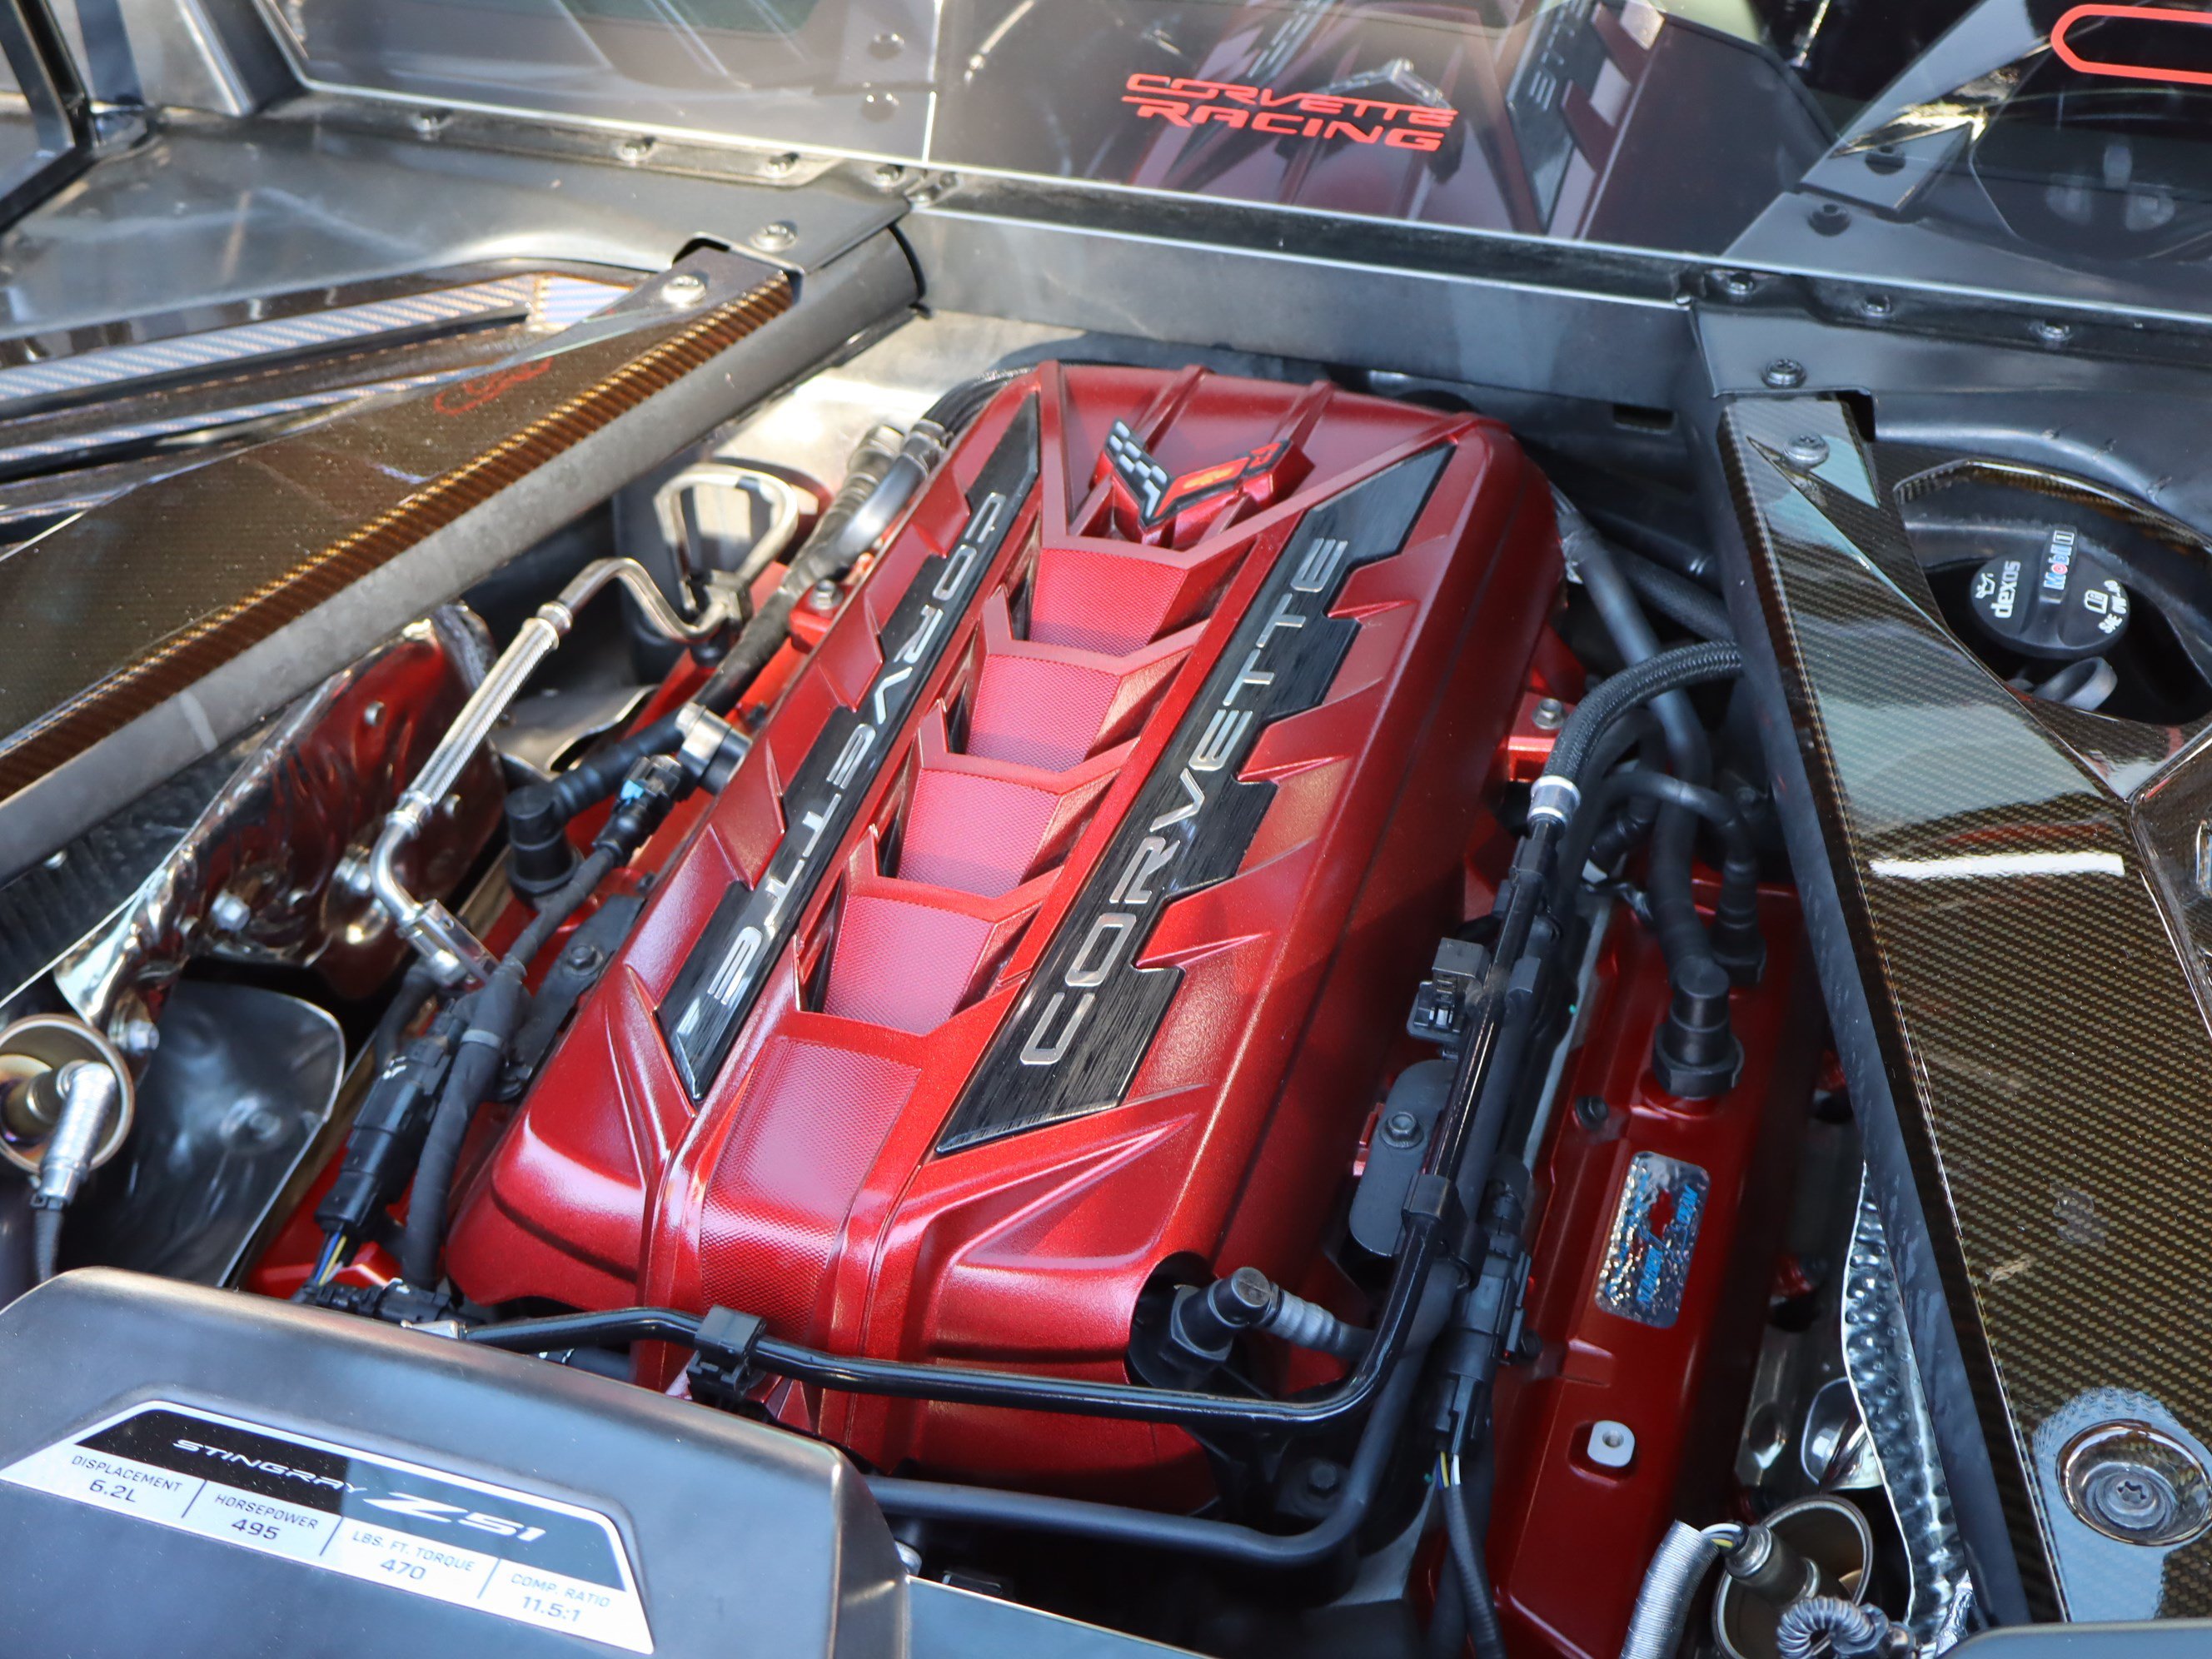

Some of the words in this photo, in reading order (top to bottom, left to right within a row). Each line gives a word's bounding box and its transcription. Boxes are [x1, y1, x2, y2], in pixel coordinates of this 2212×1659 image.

[1126, 73, 1458, 127] CORVETTE
[1122, 96, 1445, 152] RACING
[2043, 543, 2072, 590] Mobil
[1990, 560, 2021, 618] dexos
[2098, 613, 2123, 634] SAE
[707, 492, 1006, 1005] CORVETTE
[1020, 537, 1348, 1065] CORVETTE
[72, 1455, 183, 1492] DISPLACEMENT
[89, 1479, 137, 1503] 6.2L
[172, 1439, 368, 1494] STINGRAY
[362, 1492, 547, 1542] Z51
[215, 1494, 319, 1530] HORSEPOWER
[232, 1518, 281, 1541] 495
[352, 1530, 384, 1547] LBS.
[389, 1541, 411, 1555] FT.
[416, 1547, 476, 1572] TORQUE
[380, 1558, 426, 1581] 470
[511, 1573, 559, 1595] COMP.
[565, 1588, 611, 1608] RATIO
[521, 1596, 581, 1622] 11.5:1
